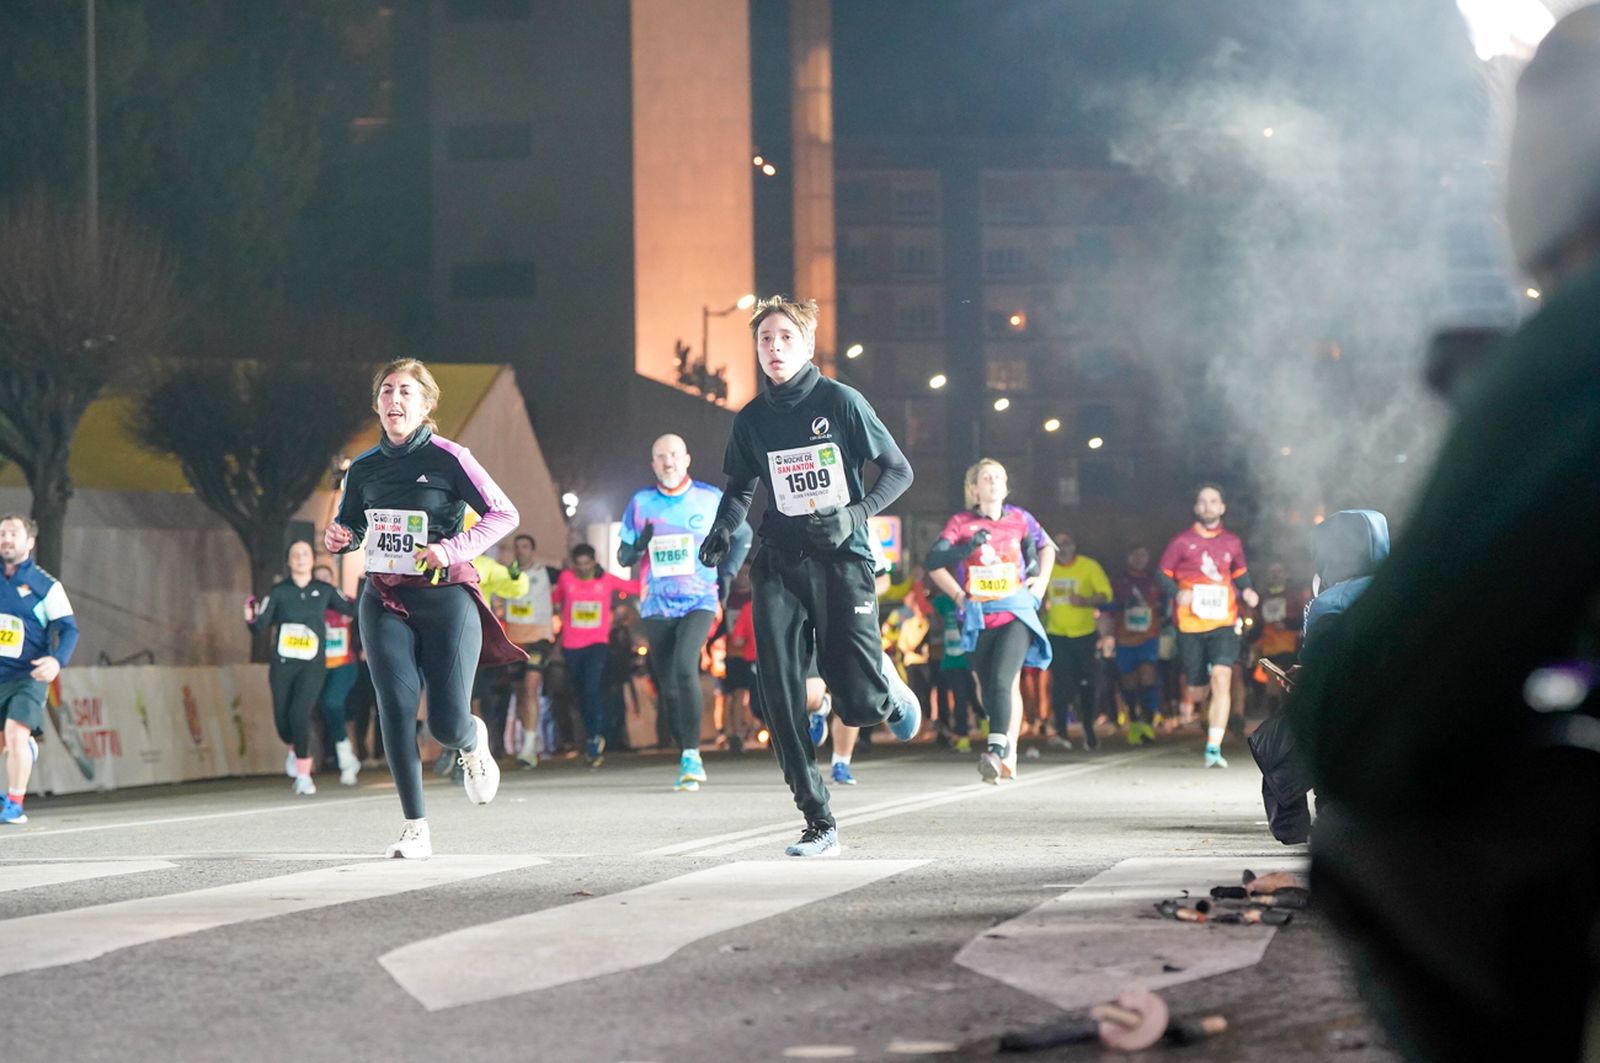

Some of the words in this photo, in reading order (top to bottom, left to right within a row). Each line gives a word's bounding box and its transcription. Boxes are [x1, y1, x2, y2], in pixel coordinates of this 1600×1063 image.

[783, 455, 804, 464] NOCHE
[804, 453, 813, 461] DE
[777, 464, 791, 474] SAN
[785, 468, 831, 493] 1509
[377, 532, 415, 553] 4359
